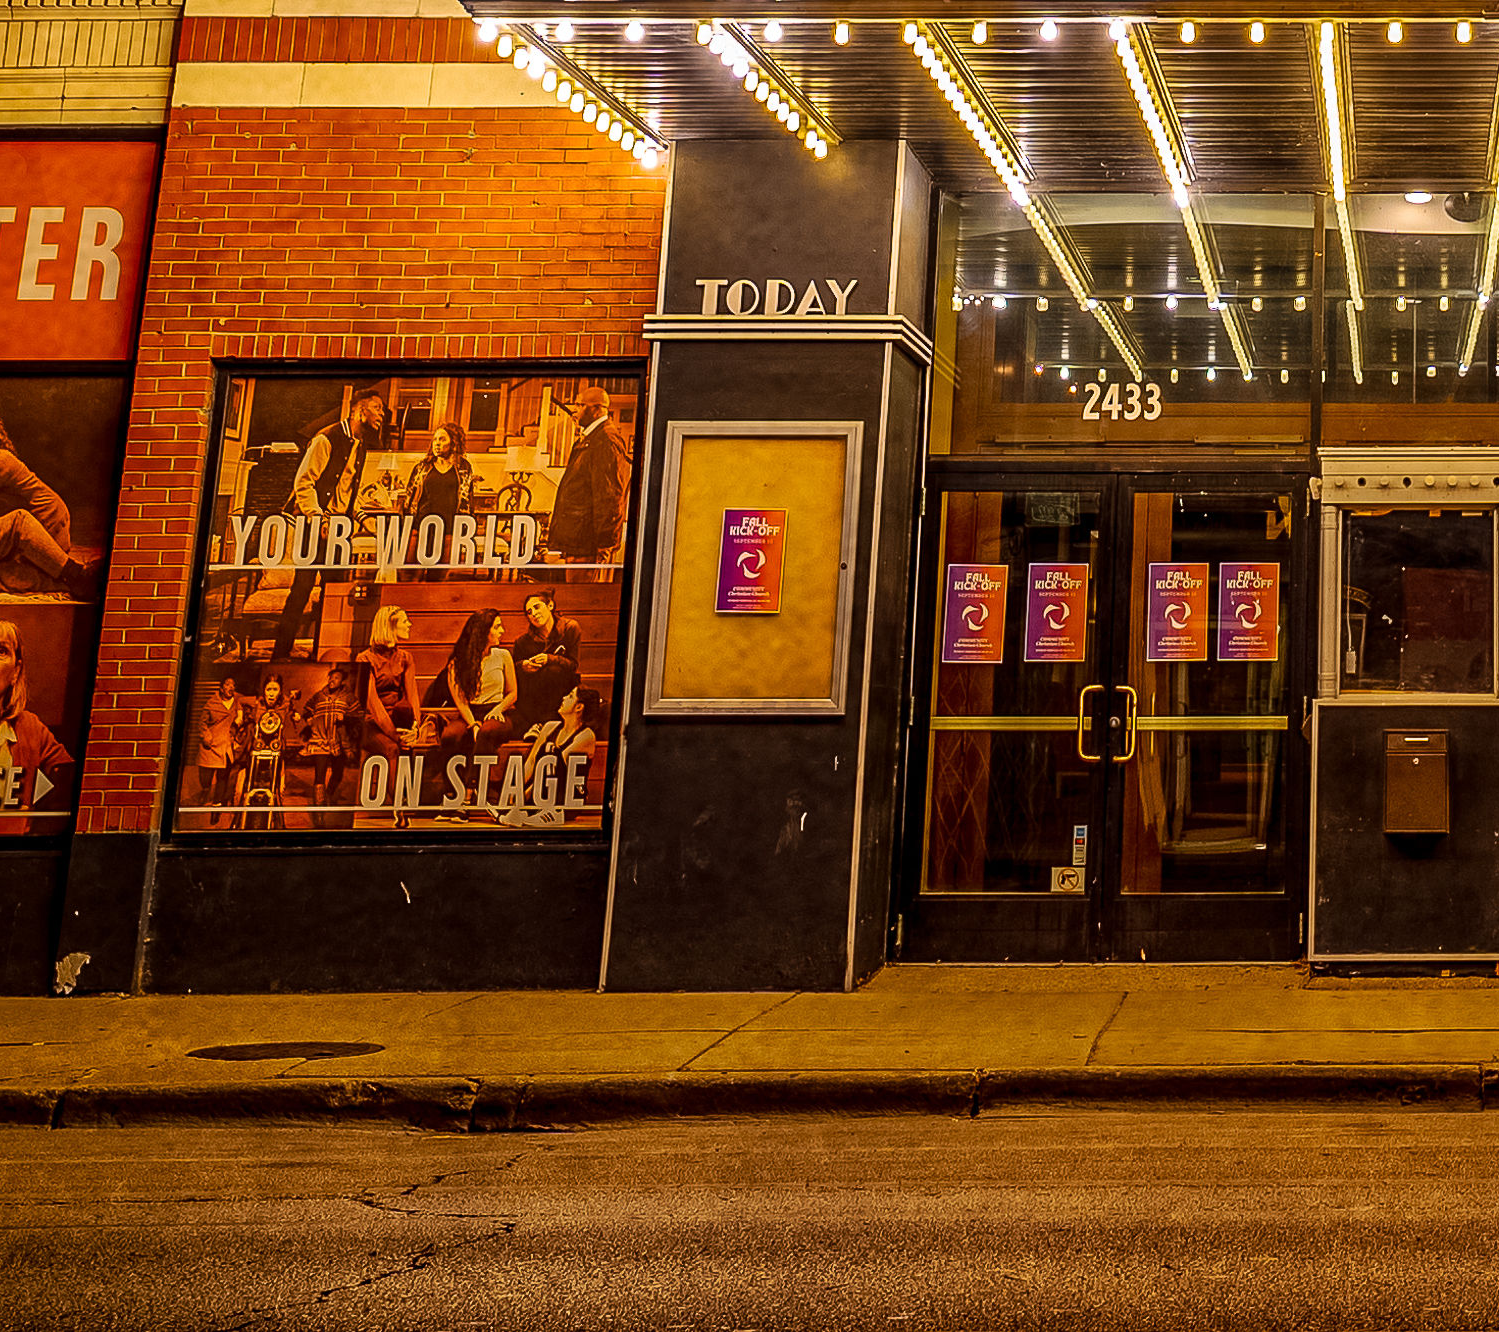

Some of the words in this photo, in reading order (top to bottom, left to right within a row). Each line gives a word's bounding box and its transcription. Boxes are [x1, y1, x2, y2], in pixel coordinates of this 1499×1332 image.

[695, 278, 859, 317] TODAY
[1082, 382, 1163, 422] 2433
[742, 517, 768, 527] FALL
[729, 526, 780, 536] KICK-OFF
[230, 515, 354, 567] YOUR
[376, 514, 539, 567] WORLD
[966, 573, 990, 582] FALL
[1046, 572, 1071, 581] FALL
[1167, 571, 1191, 580] FALL
[1237, 571, 1262, 580] FALL
[954, 581, 1002, 591] KICK-OFF
[1035, 580, 1082, 590] KICK-OFF
[1155, 579, 1203, 589] KICK-OFF
[1226, 579, 1274, 589] KICK-OFF
[359, 754, 426, 808] ON
[445, 754, 589, 808] STAGE
